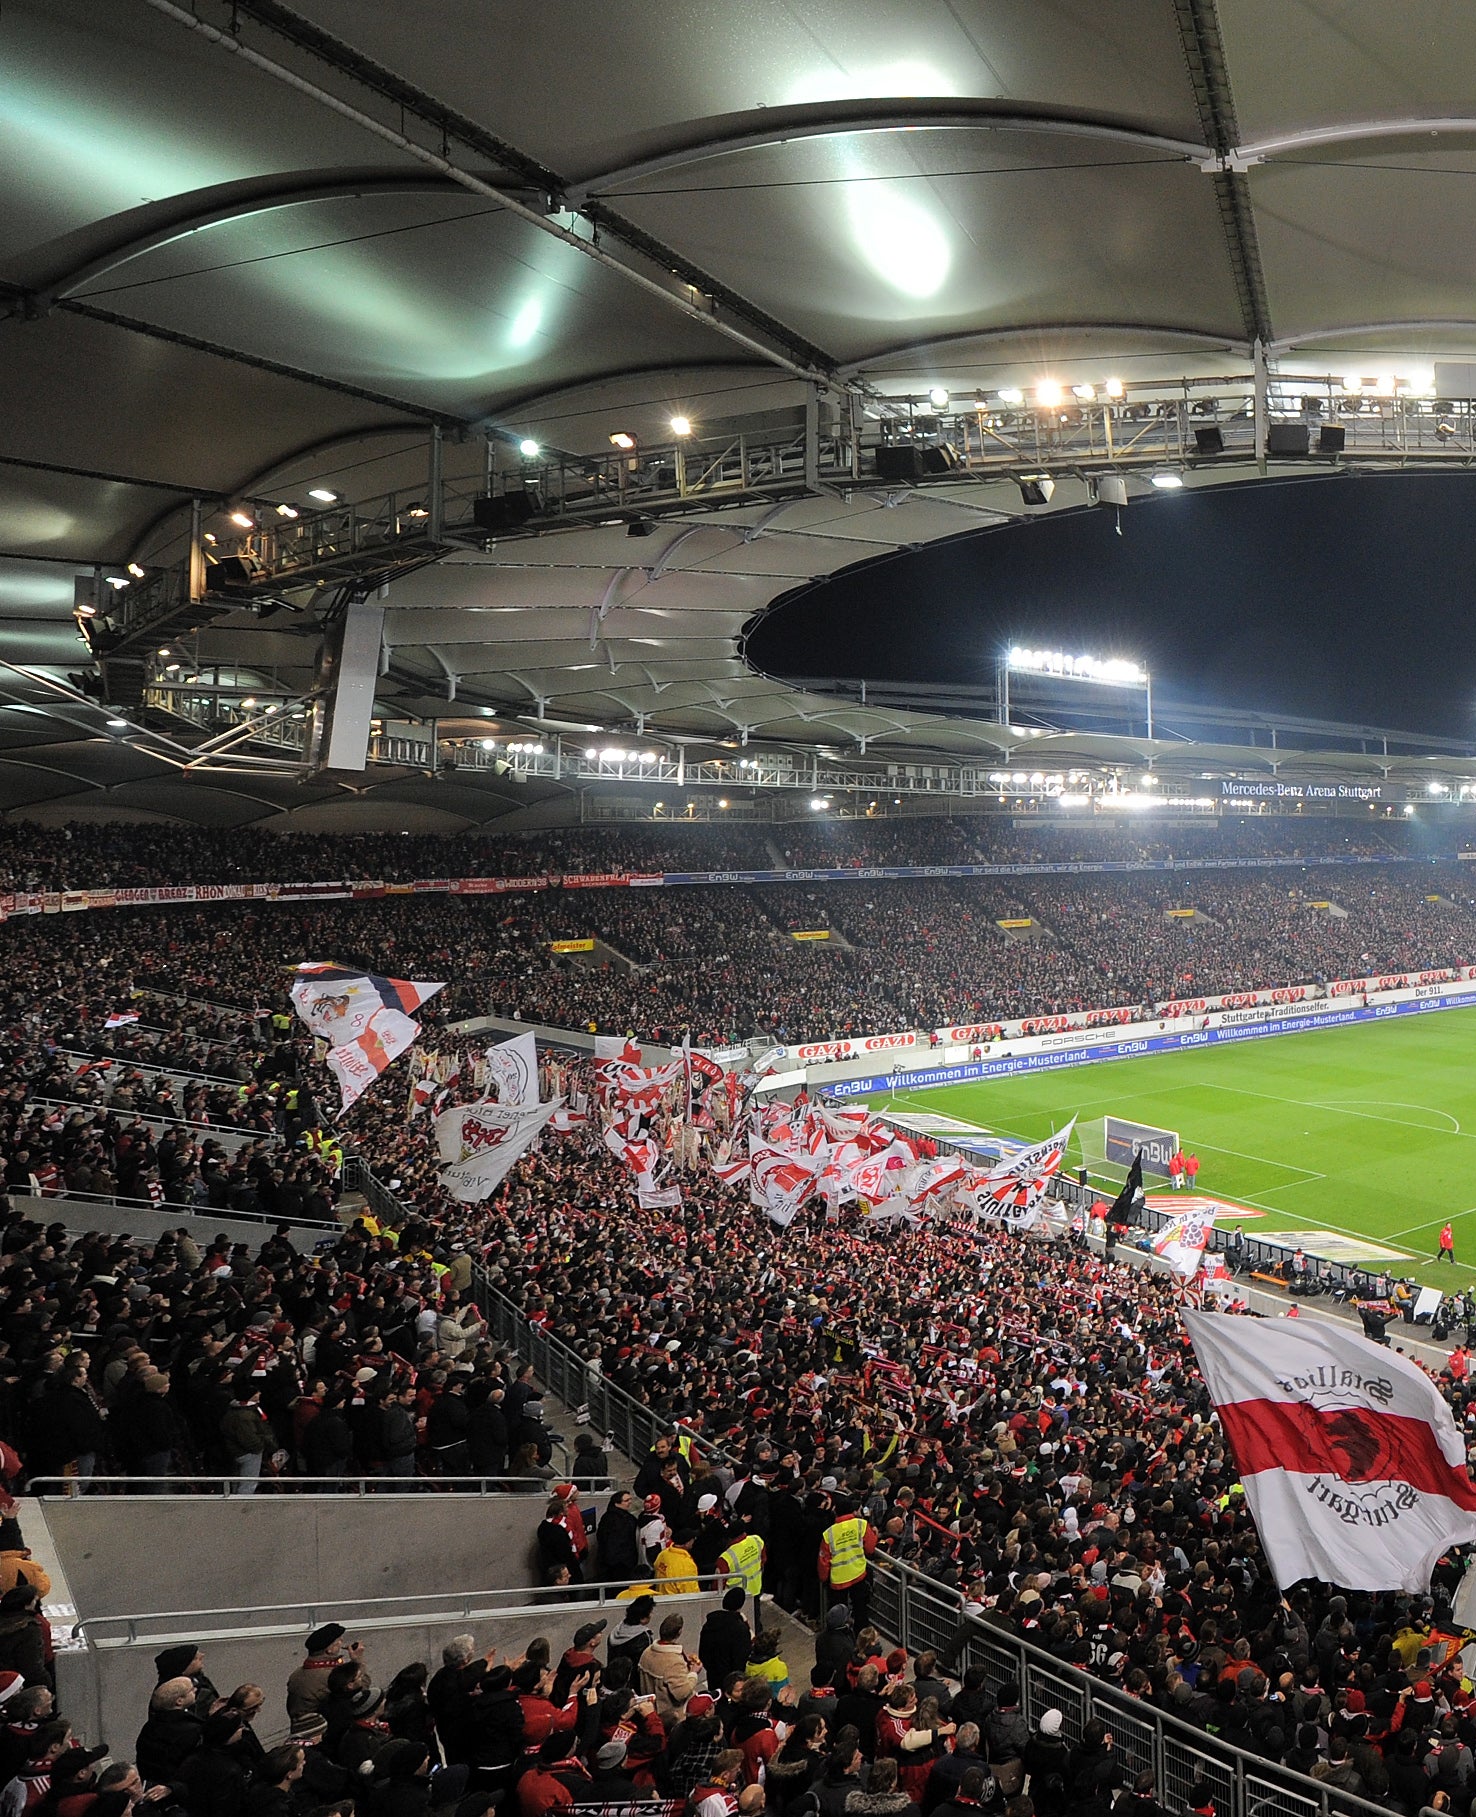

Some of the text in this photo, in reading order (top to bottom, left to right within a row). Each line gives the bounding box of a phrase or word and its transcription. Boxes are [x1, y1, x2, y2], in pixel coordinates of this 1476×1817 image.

[1222, 782, 1381, 799] Mercedes-Benz Arena Stuttgart
[708, 873, 738, 881] EnBW
[785, 871, 813, 879] EnBW
[858, 869, 884, 877] EnBW
[1415, 985, 1444, 998] Der 911.
[1272, 1003, 1330, 1017] Traditionselfer.
[1375, 1005, 1398, 1016] EnBW
[1420, 1000, 1440, 1010] EnBW
[1217, 1012, 1356, 1040] Willkommen im Energie-Musterland.
[869, 1034, 909, 1049] GAZI
[1042, 1031, 1116, 1046] PORSCHE
[1180, 1032, 1208, 1045] EnBW
[803, 1041, 847, 1058] GAZI
[1118, 1041, 1148, 1054] EnBW
[886, 1050, 1090, 1088] Willkommen im Energie-Musterland.
[835, 1080, 873, 1095] EnBW
[1132, 1138, 1173, 1166] EnBW
